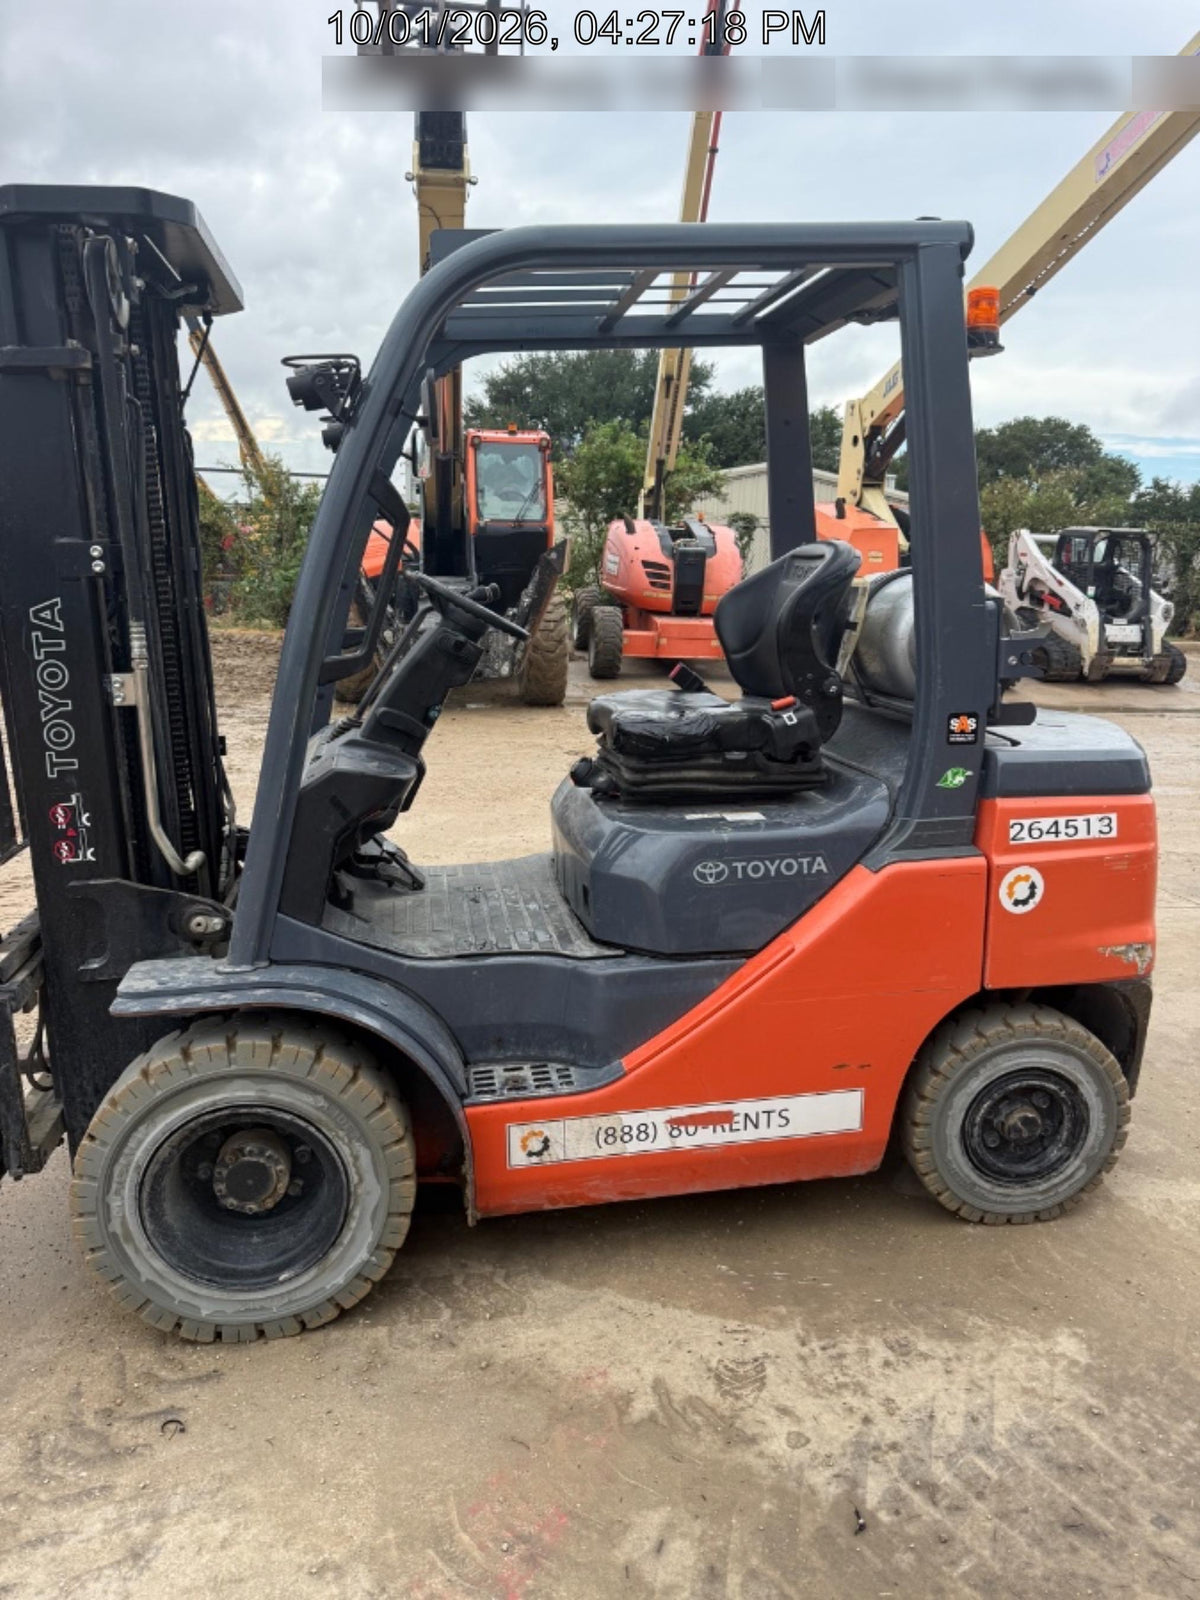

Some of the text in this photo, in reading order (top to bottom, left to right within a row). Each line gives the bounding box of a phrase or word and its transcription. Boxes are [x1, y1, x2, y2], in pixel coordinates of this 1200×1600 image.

[30, 597, 78, 778] TOYOTA
[949, 715, 977, 733] SAS
[1009, 816, 1113, 842] 264513
[732, 856, 828, 879] TOYOTA
[595, 1121, 657, 1148] (888)
